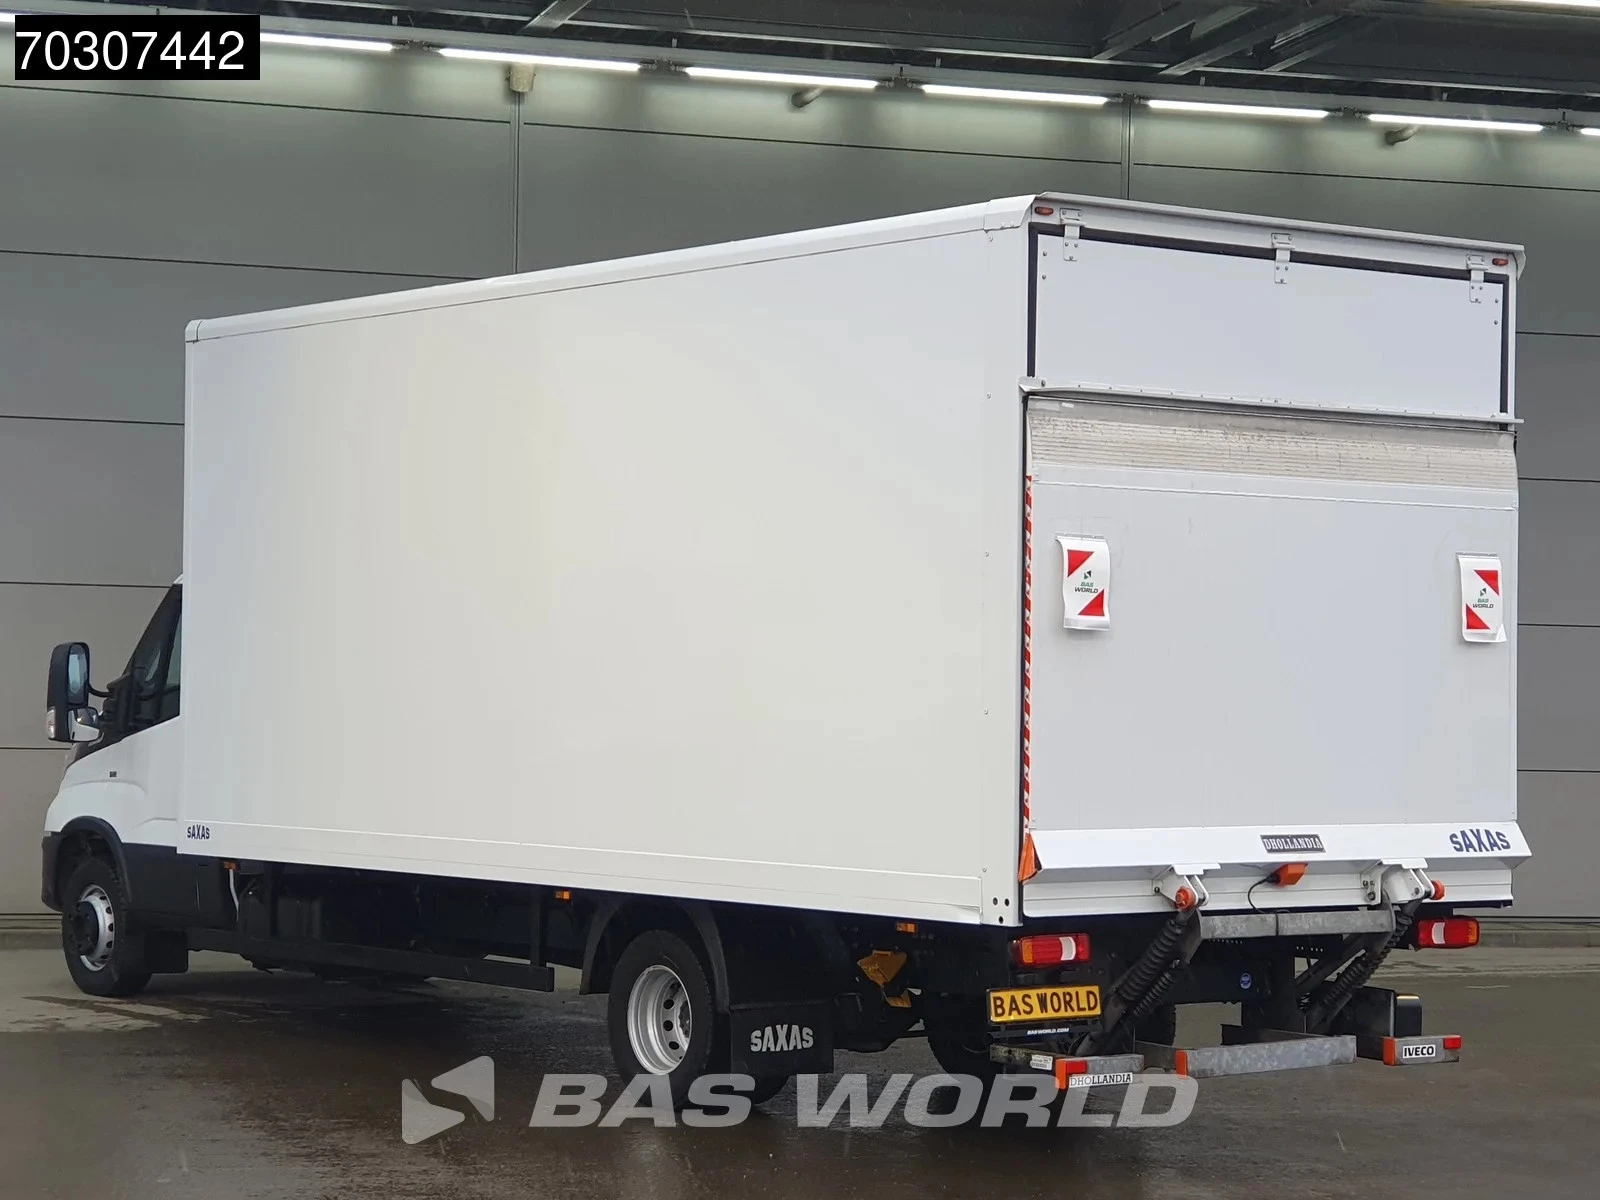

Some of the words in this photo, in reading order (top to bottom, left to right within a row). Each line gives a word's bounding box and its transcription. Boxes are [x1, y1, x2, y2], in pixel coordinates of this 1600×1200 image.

[187, 824, 210, 840] SAXAS
[1449, 828, 1511, 852] SAXAS
[1262, 837, 1324, 850] DHOLLANDIA
[992, 992, 1034, 1018] BAS
[1036, 991, 1099, 1014] WORLD
[750, 1024, 814, 1052] SAXAS
[1403, 1045, 1435, 1057] IVECO
[1069, 1073, 1132, 1087] DHOLLANDIA
